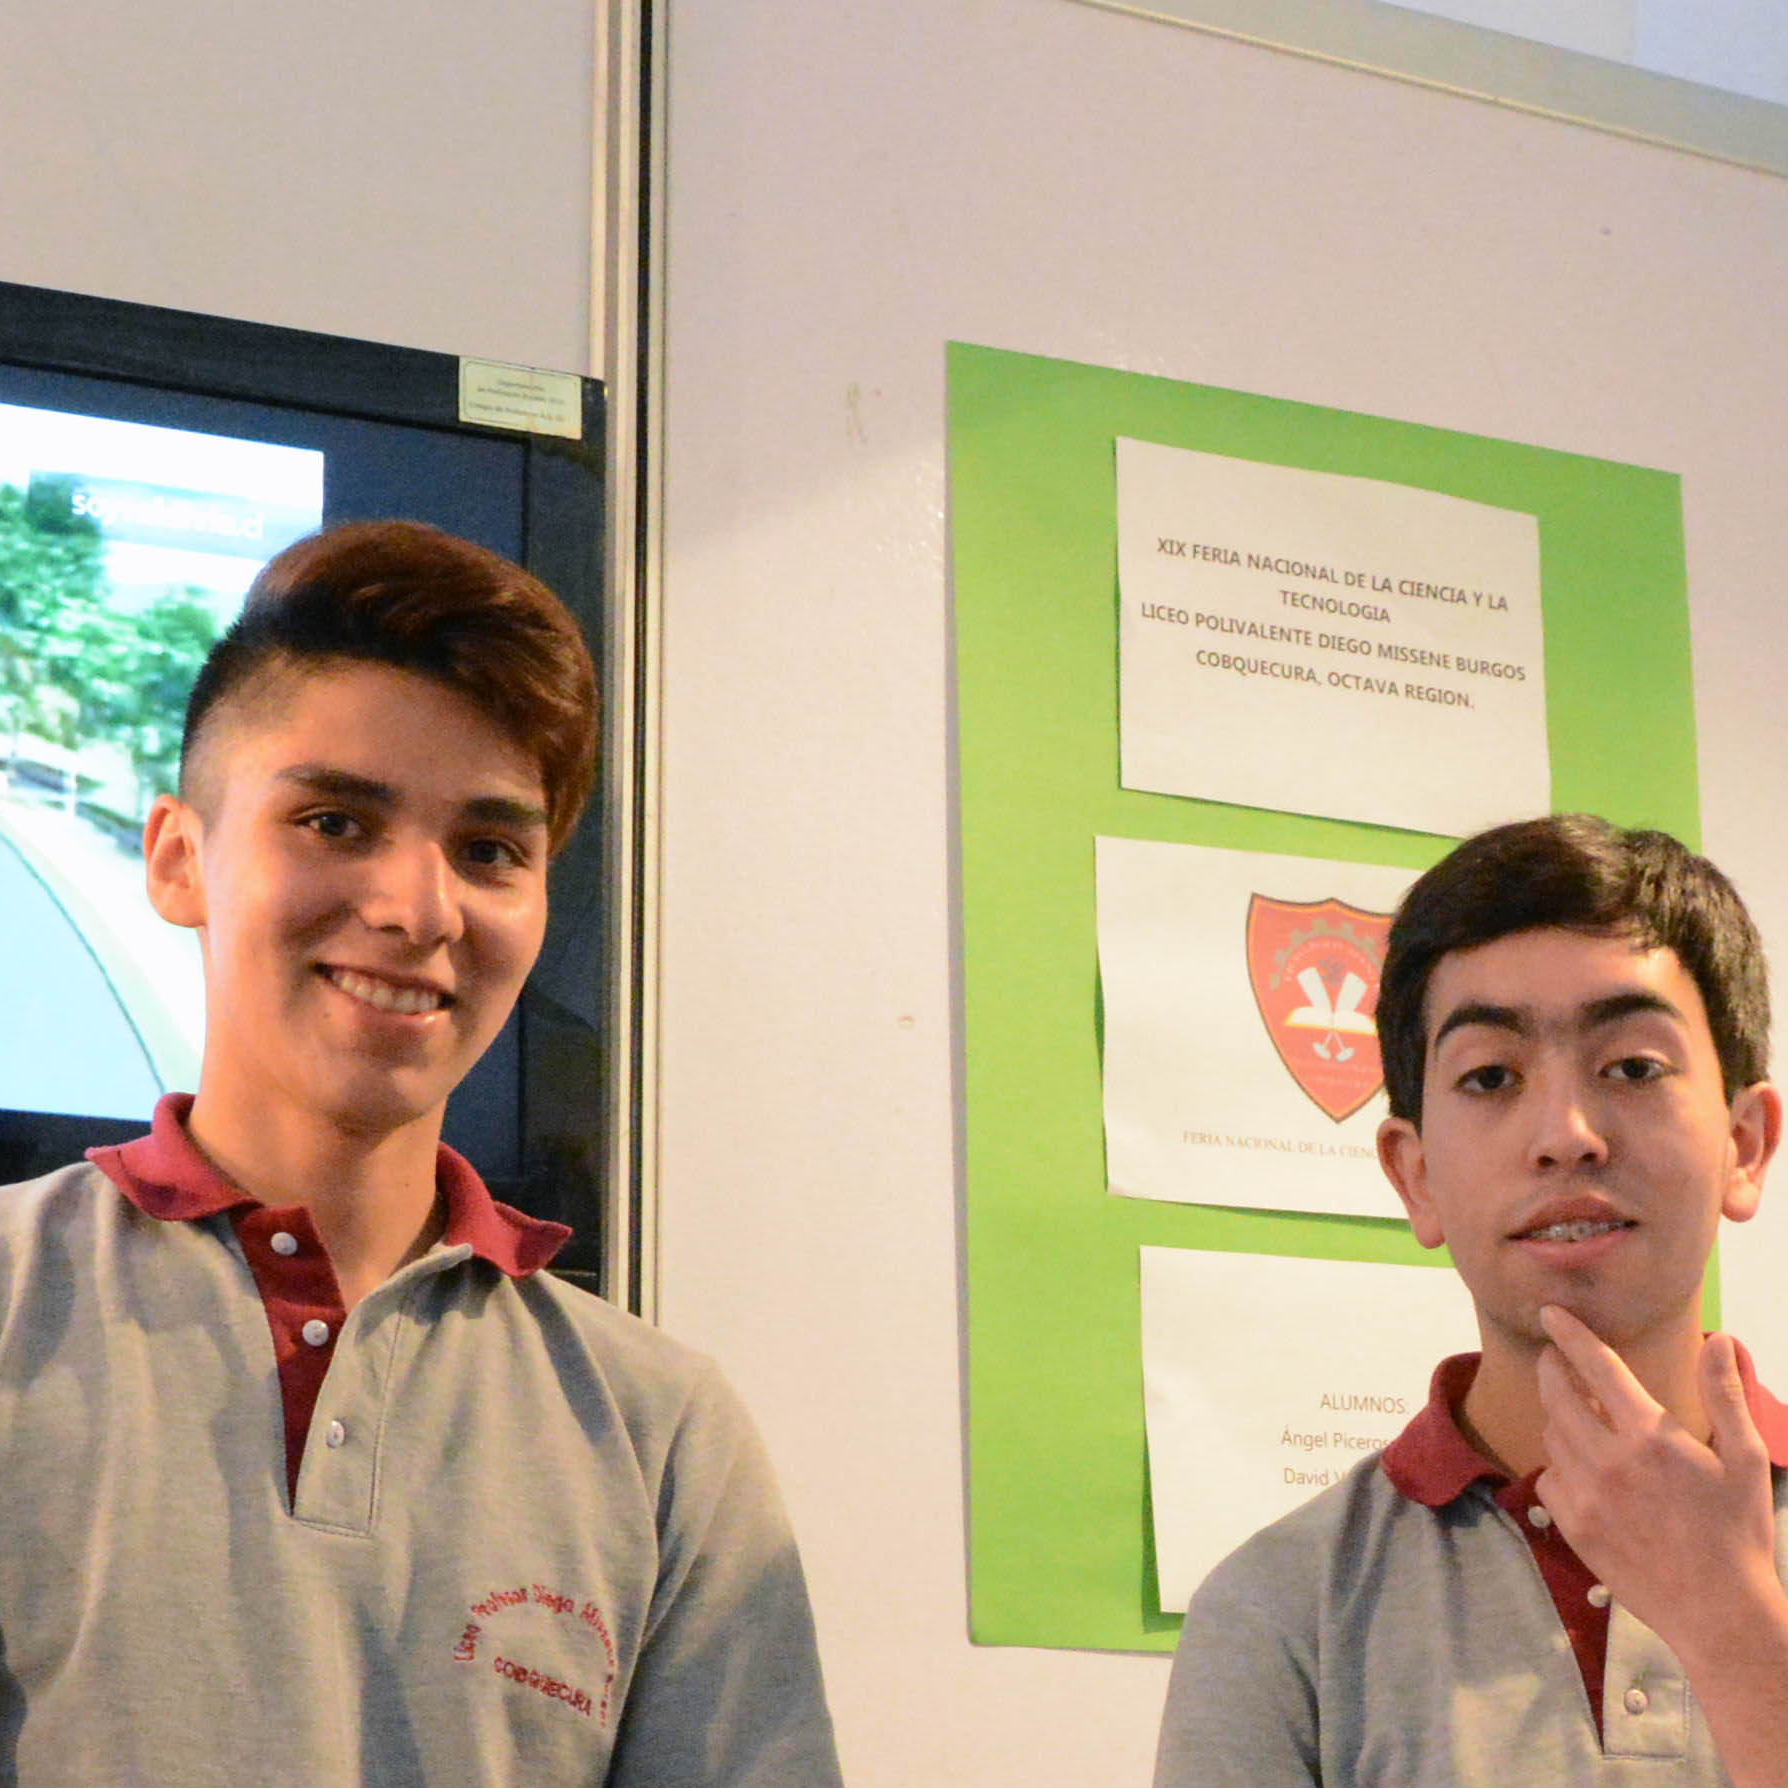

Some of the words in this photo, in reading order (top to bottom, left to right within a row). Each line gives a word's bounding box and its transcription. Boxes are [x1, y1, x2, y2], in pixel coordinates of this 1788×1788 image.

[1157, 537, 1187, 558] XIX
[1193, 543, 1241, 567] FERIA
[1248, 553, 1339, 584] NACIONAL
[1344, 571, 1366, 589] DE
[1372, 575, 1393, 593] LA
[1399, 579, 1468, 605] CIENCIA
[1473, 591, 1483, 607] Y
[1489, 595, 1509, 612] LA
[1279, 589, 1391, 623] TECNOLOGIA
[1141, 601, 1189, 626] LICEO
[1195, 612, 1312, 647] POLIVALENTE
[1319, 633, 1372, 656] DIEGO
[1378, 642, 1451, 670] MISSENE
[1456, 656, 1527, 682] BURGOS
[1328, 670, 1399, 697] OCTAVA
[1405, 683, 1476, 710] REGION.
[1183, 1130, 1222, 1148] FERIA
[1226, 1135, 1294, 1153] NACIONAL
[1299, 1141, 1316, 1155] DE
[1320, 1142, 1337, 1156] LA
[1281, 1424, 1328, 1452] Ángel
[1284, 1466, 1329, 1486] David
[493, 1655, 592, 1717] COBQUECURA
